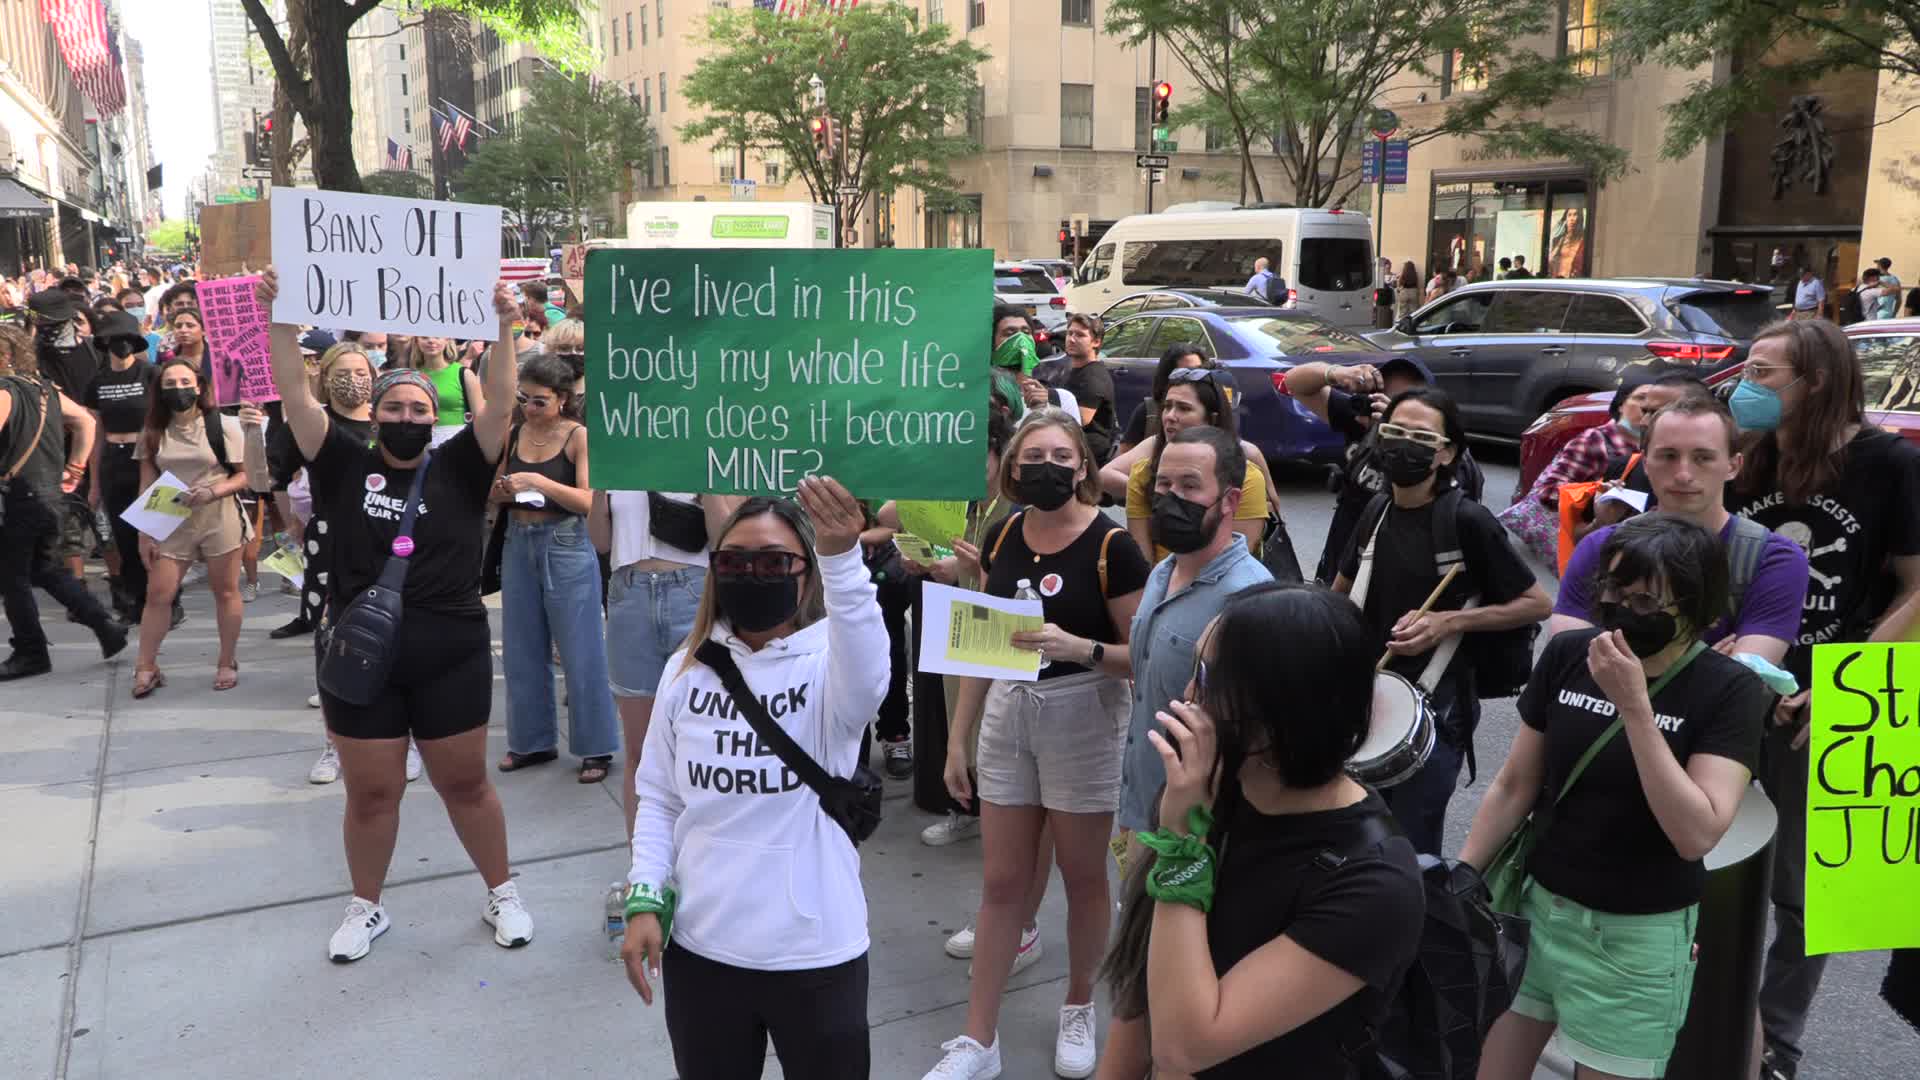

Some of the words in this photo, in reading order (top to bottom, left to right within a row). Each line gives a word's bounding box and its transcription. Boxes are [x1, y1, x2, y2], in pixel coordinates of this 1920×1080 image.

[404, 207, 480, 259] OFF
[214, 286, 231, 295] WILL
[233, 283, 251, 293] SAVE
[215, 296, 232, 305] WILL
[234, 294, 252, 304] SAVE
[377, 266, 486, 326] Bodies
[610, 264, 672, 315] I've
[694, 264, 777, 317] lived
[793, 276, 823, 320] in
[840, 272, 916, 326] this
[217, 306, 234, 316] WILL
[235, 304, 254, 314] SAVE
[237, 315, 255, 325] SAVE
[221, 327, 237, 337] WILL
[239, 340, 260, 358] PILLS
[244, 356, 264, 367] SAVE
[607, 332, 698, 390] body
[719, 346, 770, 392] my
[788, 337, 885, 385] whole
[900, 339, 966, 389] life.
[246, 366, 266, 377] SAVE
[248, 376, 268, 388] SAVE
[599, 391, 690, 440] When
[705, 396, 789, 442] does
[809, 399, 833, 444] it
[846, 399, 976, 446] become
[707, 446, 824, 493] MINE?
[1737, 491, 1784, 519] MAKE
[1806, 494, 1861, 534] SCISTS
[1803, 595, 1835, 611] ULI
[688, 682, 809, 721] UNCK
[1558, 689, 1616, 717] UNITED
[1830, 648, 1920, 732] St
[713, 729, 777, 757] THE
[687, 760, 803, 794] WORLD
[1813, 805, 1920, 868] JU
